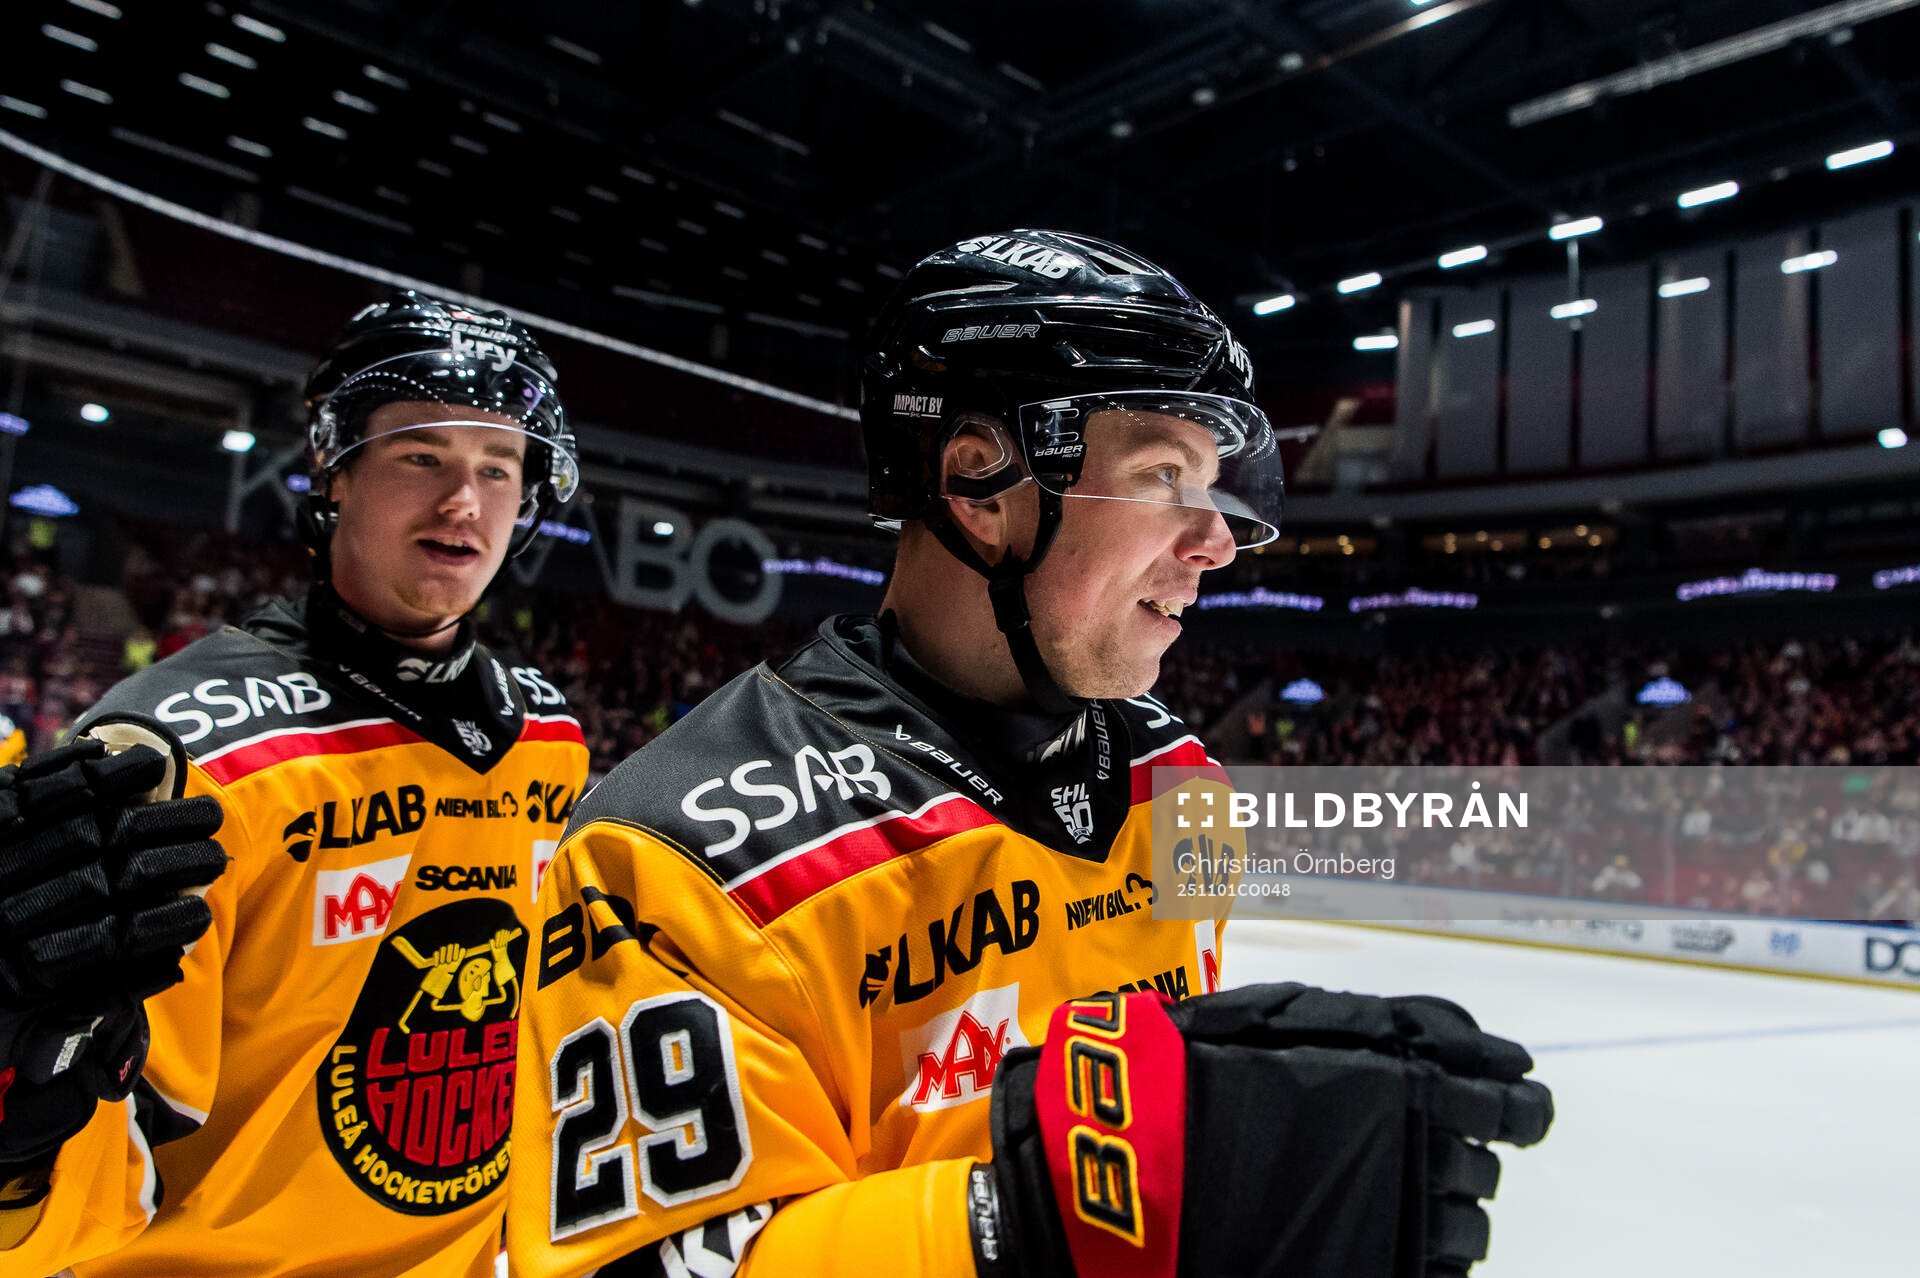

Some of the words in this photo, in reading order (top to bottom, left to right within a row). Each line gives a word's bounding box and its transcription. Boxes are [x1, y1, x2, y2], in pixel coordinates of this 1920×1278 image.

[980, 238, 1070, 279] LKAB
[451, 326, 517, 372] kry
[893, 393, 928, 412] IMPACT
[928, 397, 943, 414] BY
[154, 672, 331, 745] SSAB
[318, 784, 427, 850] LKAB
[435, 797, 484, 818] NIEMI
[681, 743, 891, 858] SSAB
[1051, 783, 1089, 806] SHL
[1055, 801, 1094, 841] 50
[415, 865, 518, 891] SCANIA
[894, 880, 1040, 1005] LKAB
[1065, 894, 1105, 931] NIEMI
[366, 1018, 520, 1079] LULE
[911, 1010, 1009, 1105] MAX
[330, 1045, 368, 1150] LULEÅ
[366, 1059, 517, 1167] HOCKE
[550, 991, 753, 1242] 29
[1065, 993, 1145, 1248] BAU
